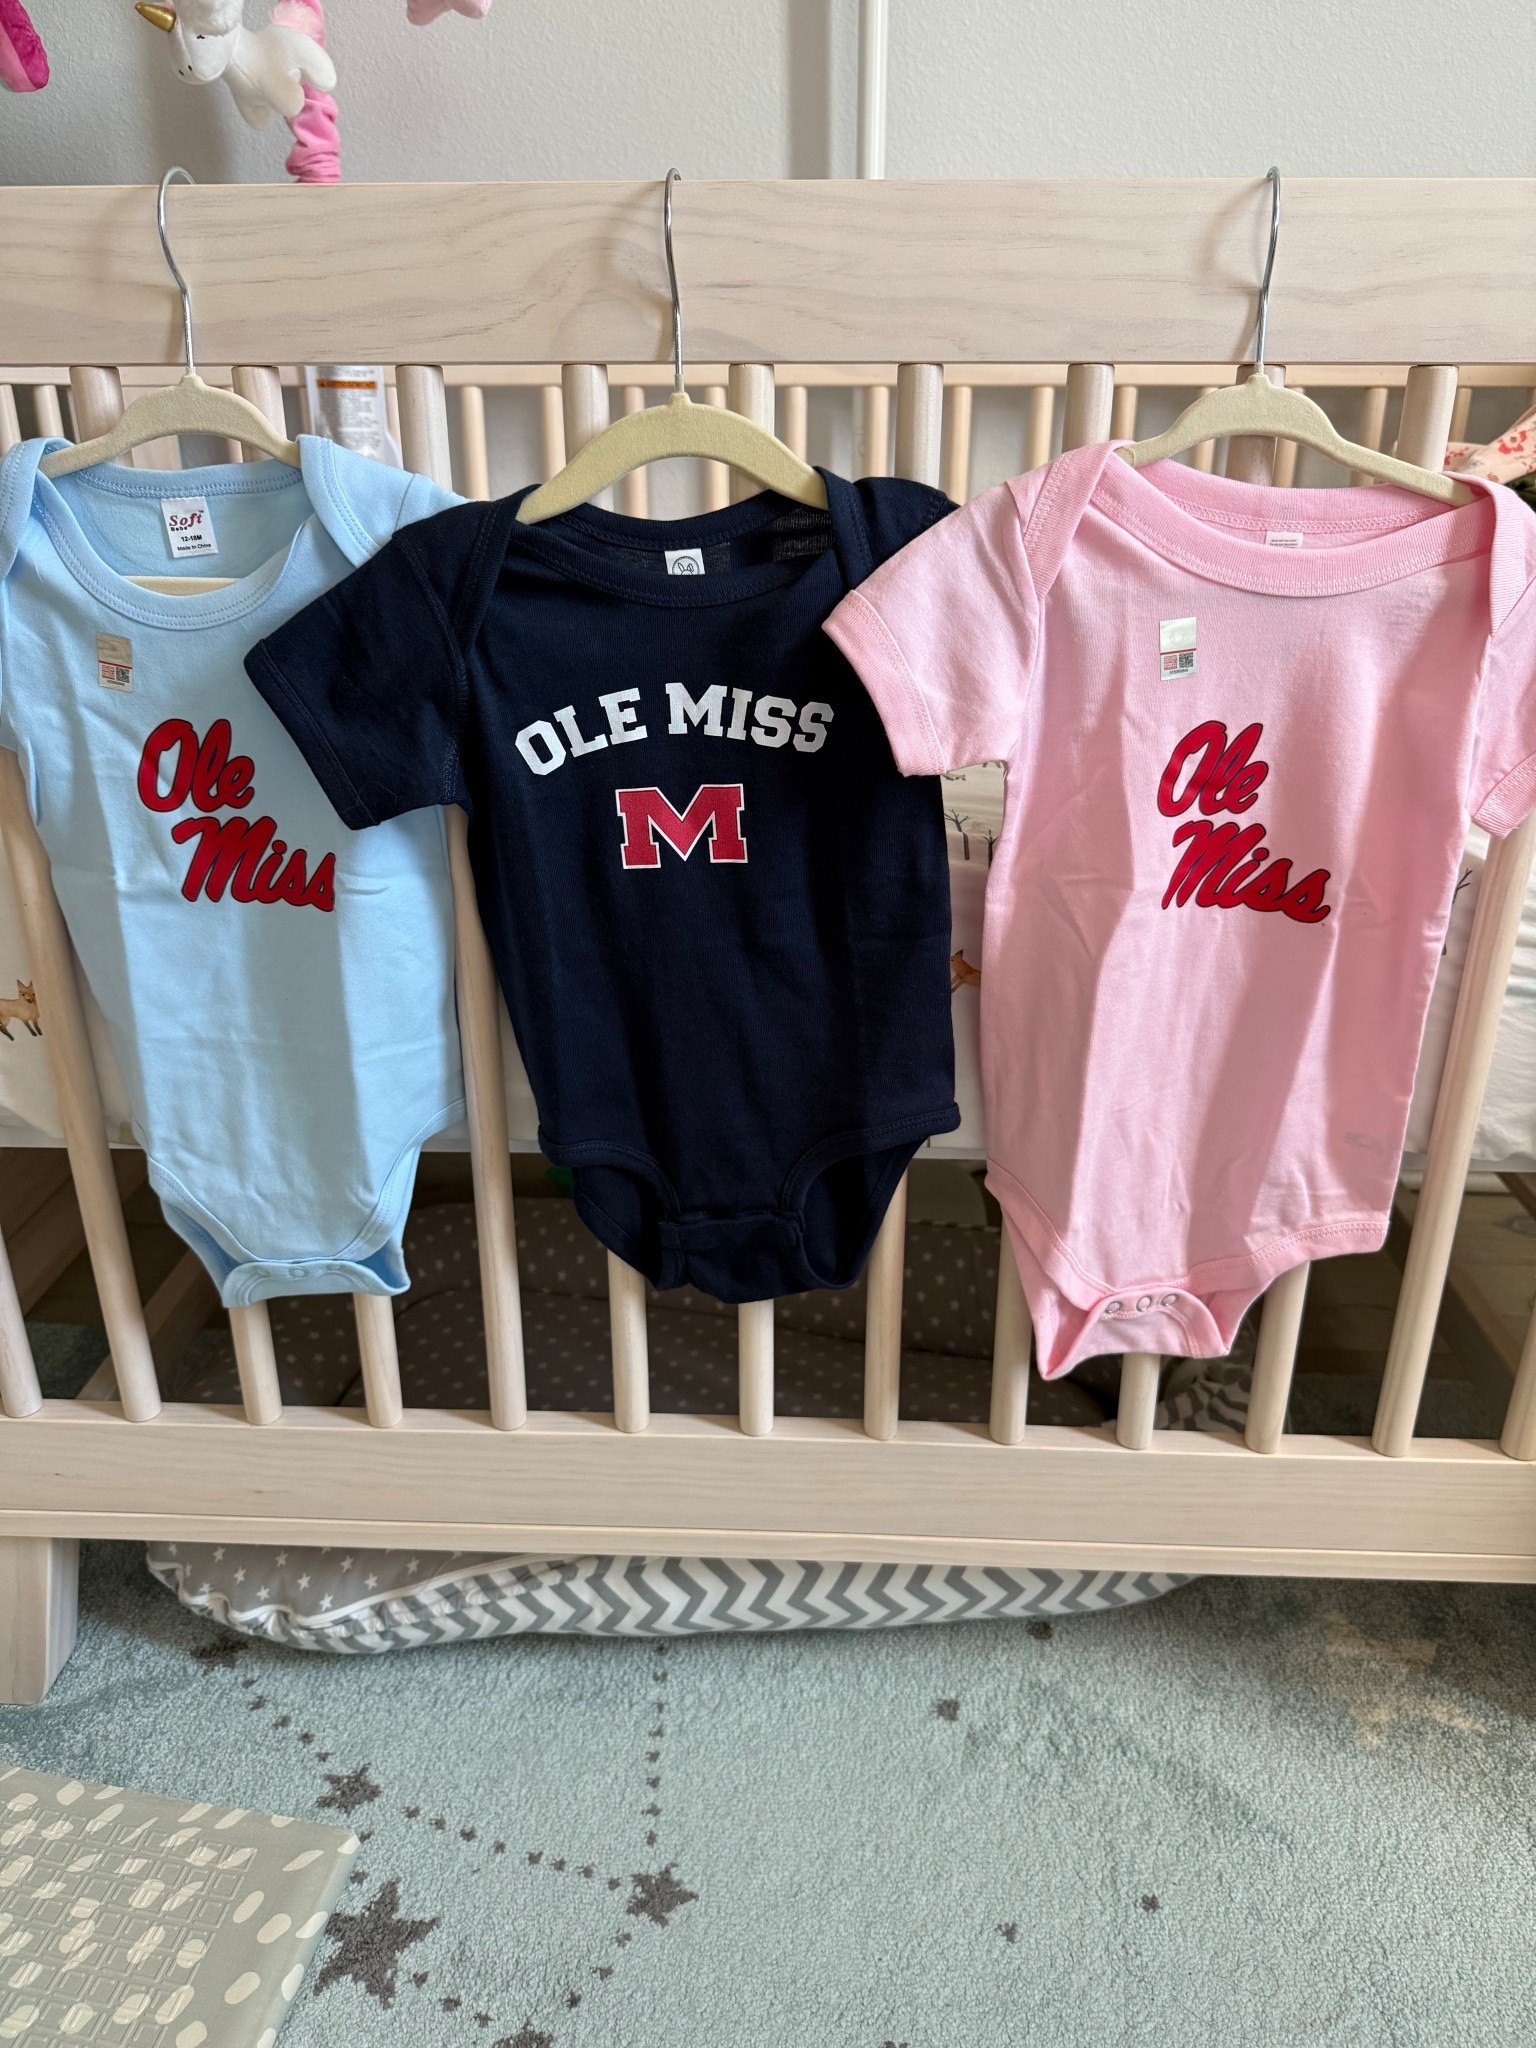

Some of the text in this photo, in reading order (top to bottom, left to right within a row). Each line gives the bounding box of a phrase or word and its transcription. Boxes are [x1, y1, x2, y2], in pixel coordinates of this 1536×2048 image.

[169, 512, 202, 527] Soft
[181, 534, 202, 542] 12-18M
[137, 718, 255, 813] Ole
[515, 682, 834, 776] OLE MISS
[1157, 720, 1269, 817] Ole
[171, 815, 336, 912] Miss
[615, 783, 748, 869] M
[1161, 819, 1331, 923] Miss
